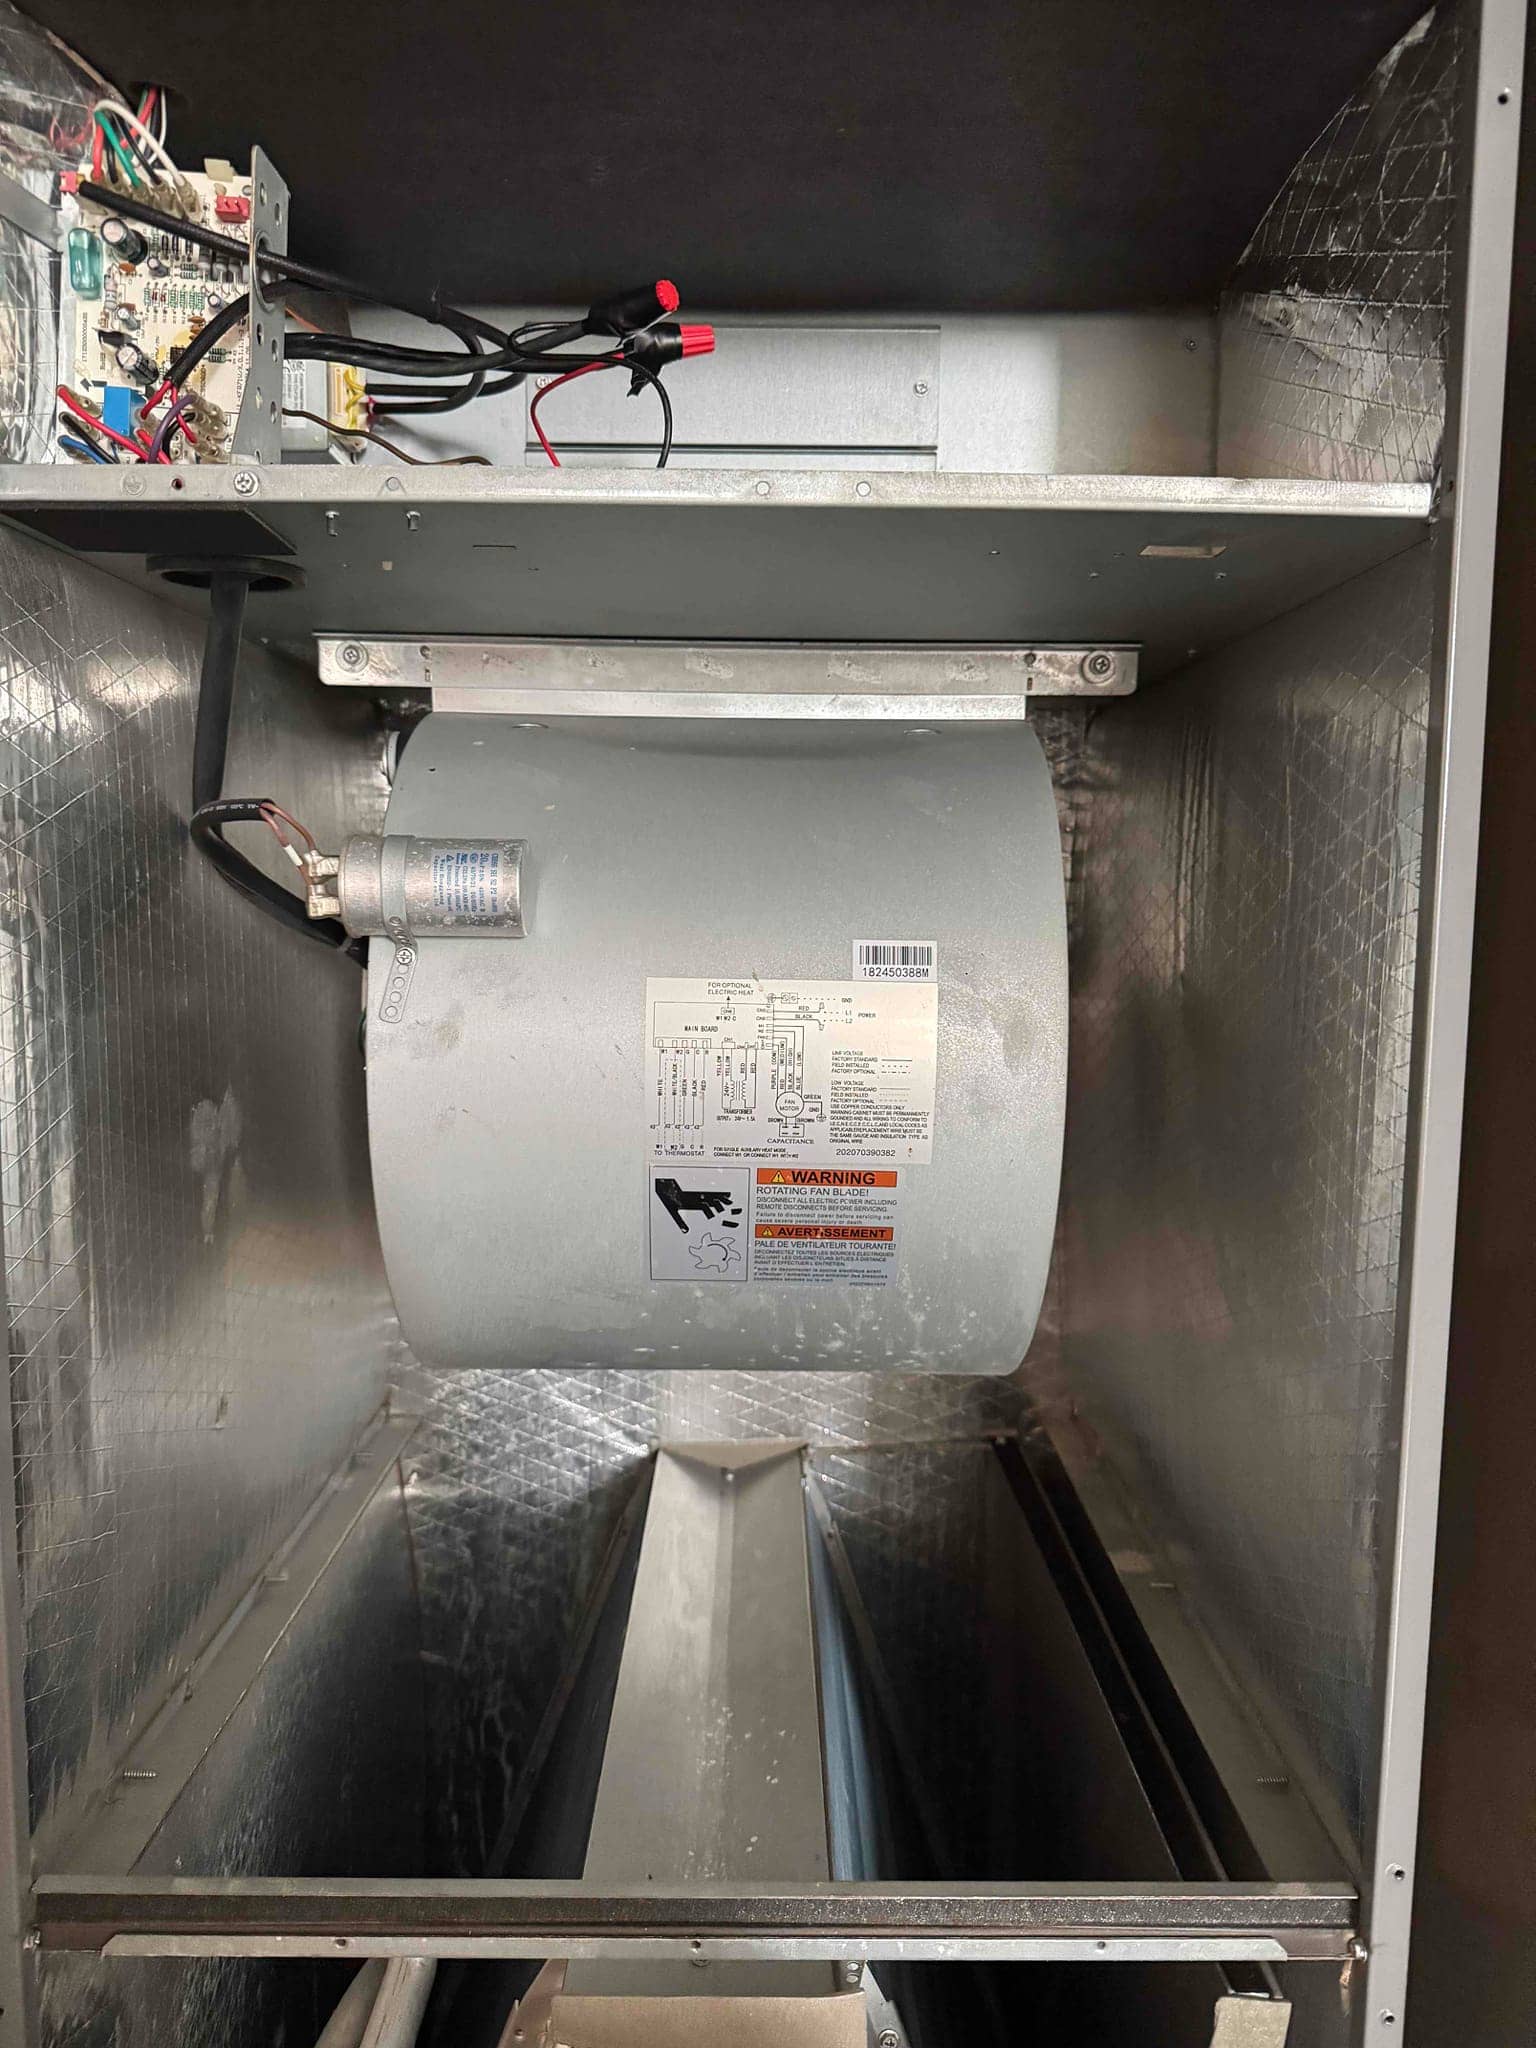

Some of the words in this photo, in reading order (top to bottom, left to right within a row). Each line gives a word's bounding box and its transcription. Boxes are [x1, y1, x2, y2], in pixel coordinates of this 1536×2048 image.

[863, 968, 929, 978] 182450388M
[835, 1149, 896, 1157] 202070390382
[791, 1171, 876, 1185] WARNING
[756, 1186, 808, 1195] ROTATING
[810, 1187, 830, 1195] FAN
[832, 1188, 869, 1197] BLADE!
[777, 1227, 886, 1238] AVERTISSEMENT
[754, 1240, 776, 1248] PALE
[790, 1241, 847, 1249] VENTILATEUR
[849, 1242, 897, 1250] TOURANTE!
